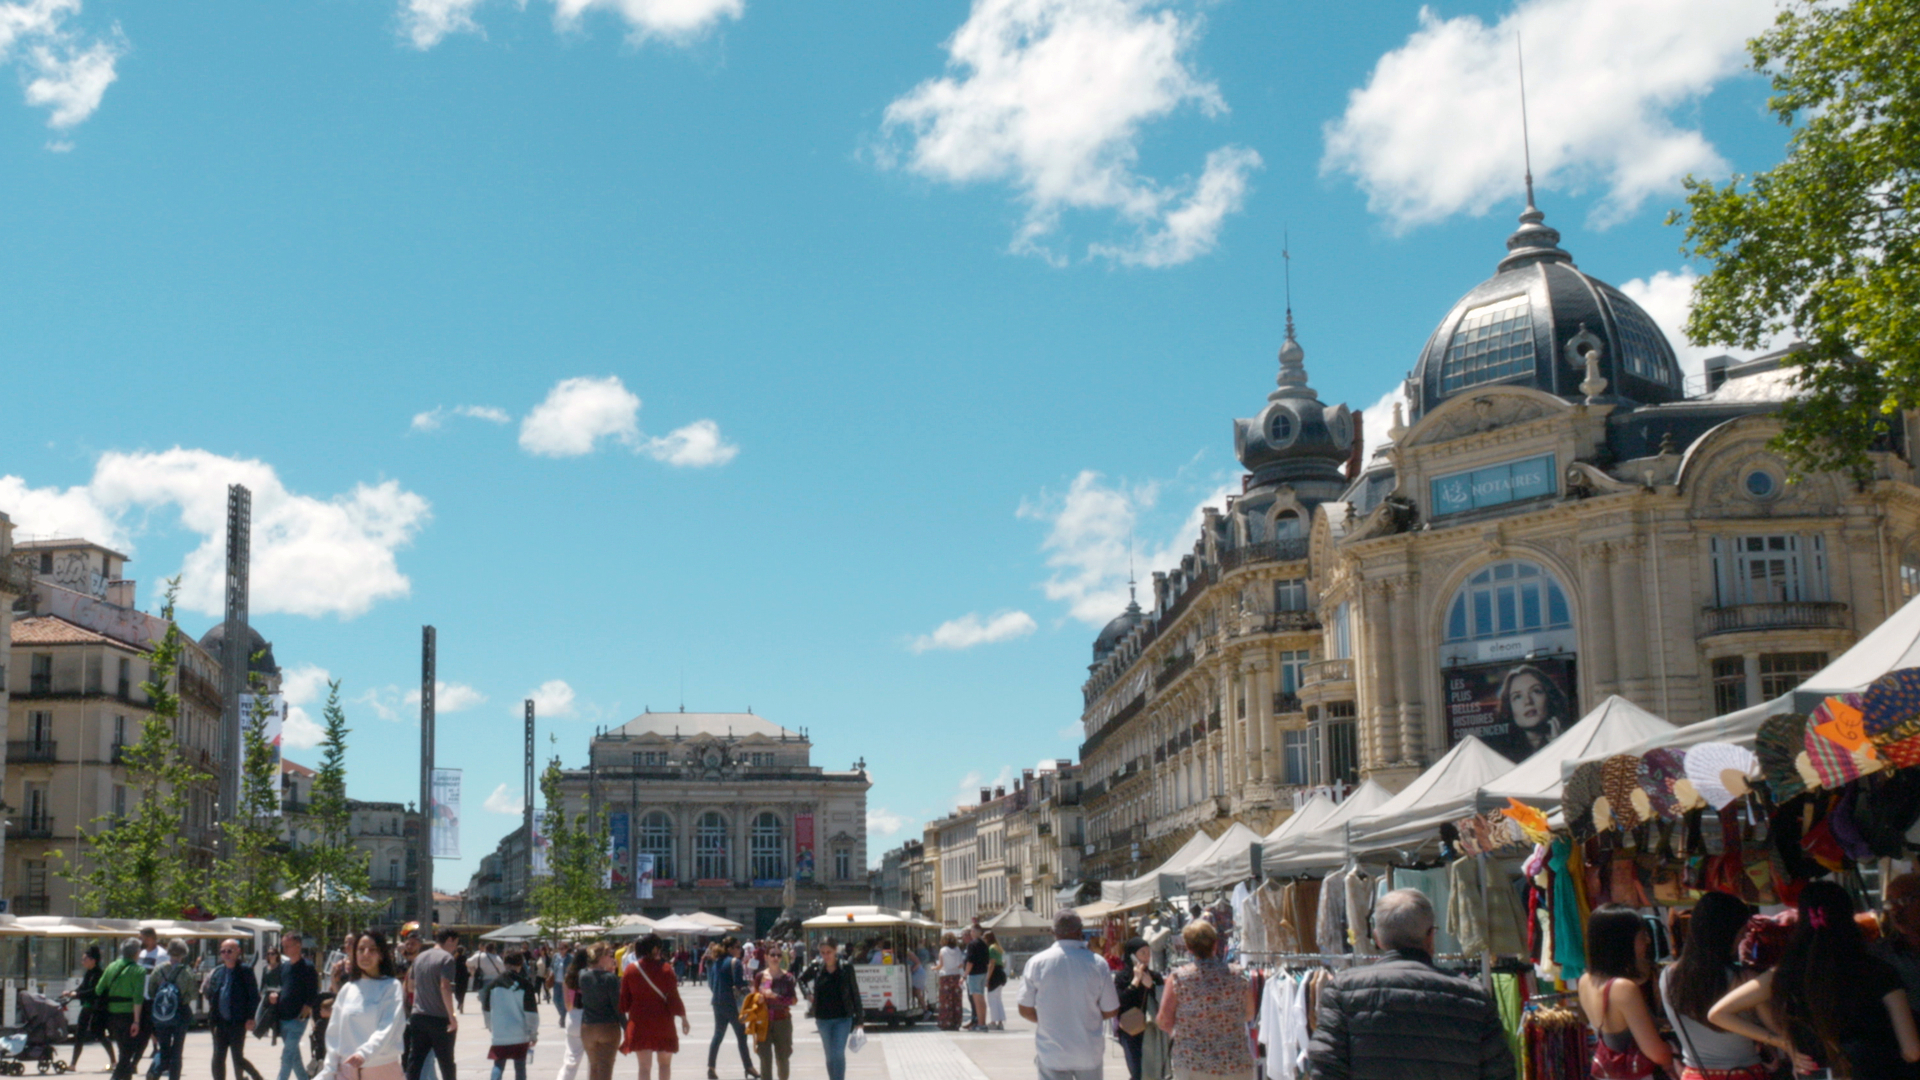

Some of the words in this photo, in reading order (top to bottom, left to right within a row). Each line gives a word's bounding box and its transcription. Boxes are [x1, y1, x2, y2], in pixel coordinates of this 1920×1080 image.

[1472, 472, 1541, 497] NOTAIRES
[1450, 678, 1465, 690] LES
[1451, 690, 1472, 702] PLUS
[1452, 701, 1481, 715] BELLES
[1453, 713, 1495, 727] HISTOIRES
[1453, 723, 1510, 740] COMMENCENT
